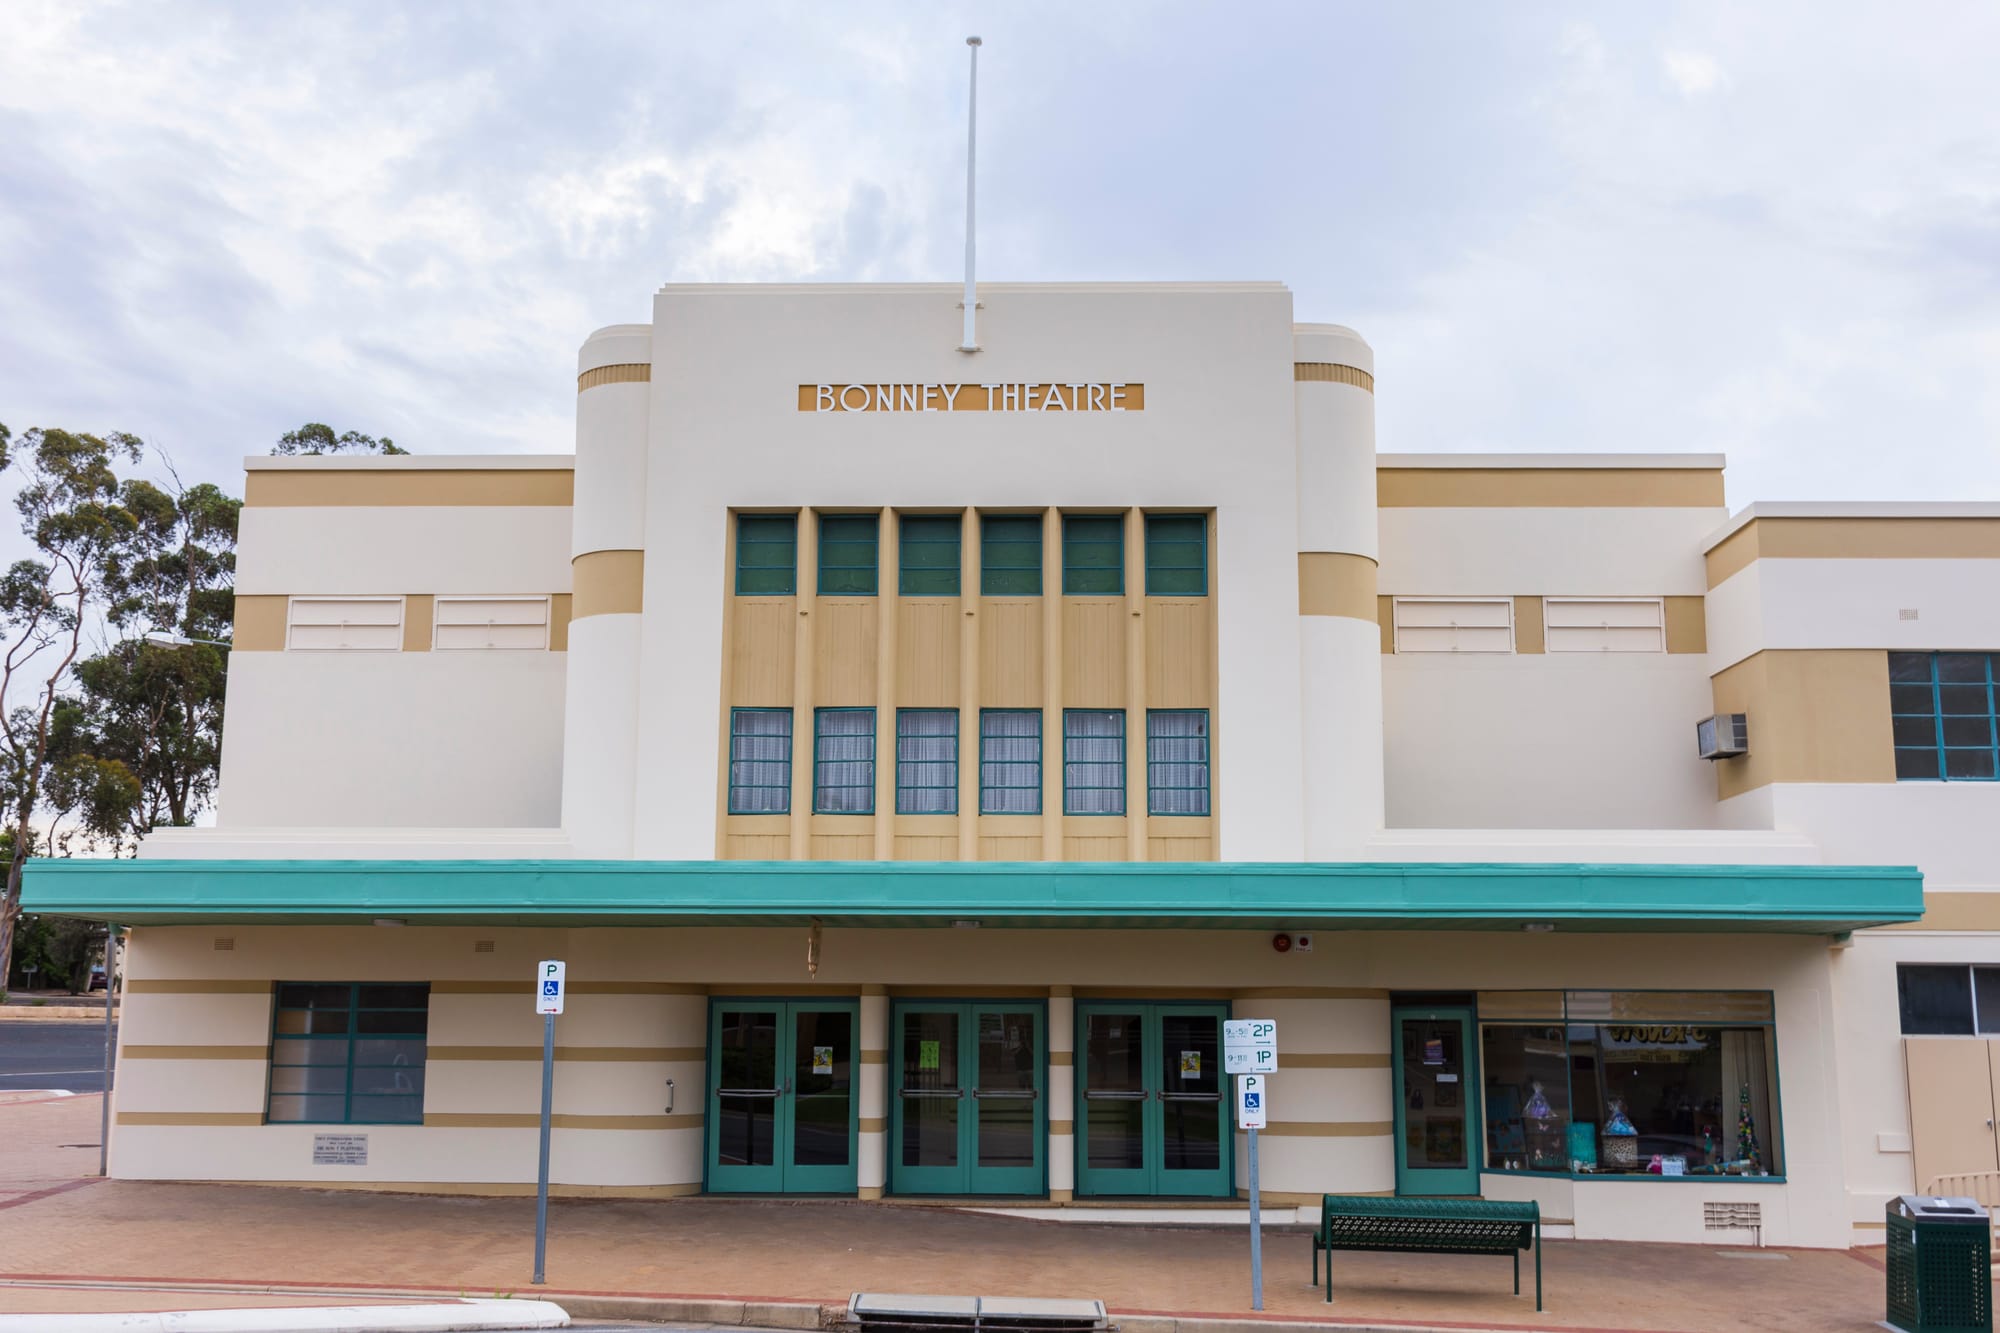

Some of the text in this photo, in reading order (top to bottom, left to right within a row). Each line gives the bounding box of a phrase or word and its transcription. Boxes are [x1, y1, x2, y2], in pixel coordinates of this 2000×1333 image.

[816, 384, 1125, 412] BONNEY THEATRE
[547, 965, 557, 976] P
[1253, 1024, 1273, 1036] 2P
[1257, 1051, 1271, 1063] 1P
[1246, 1077, 1256, 1090] P
